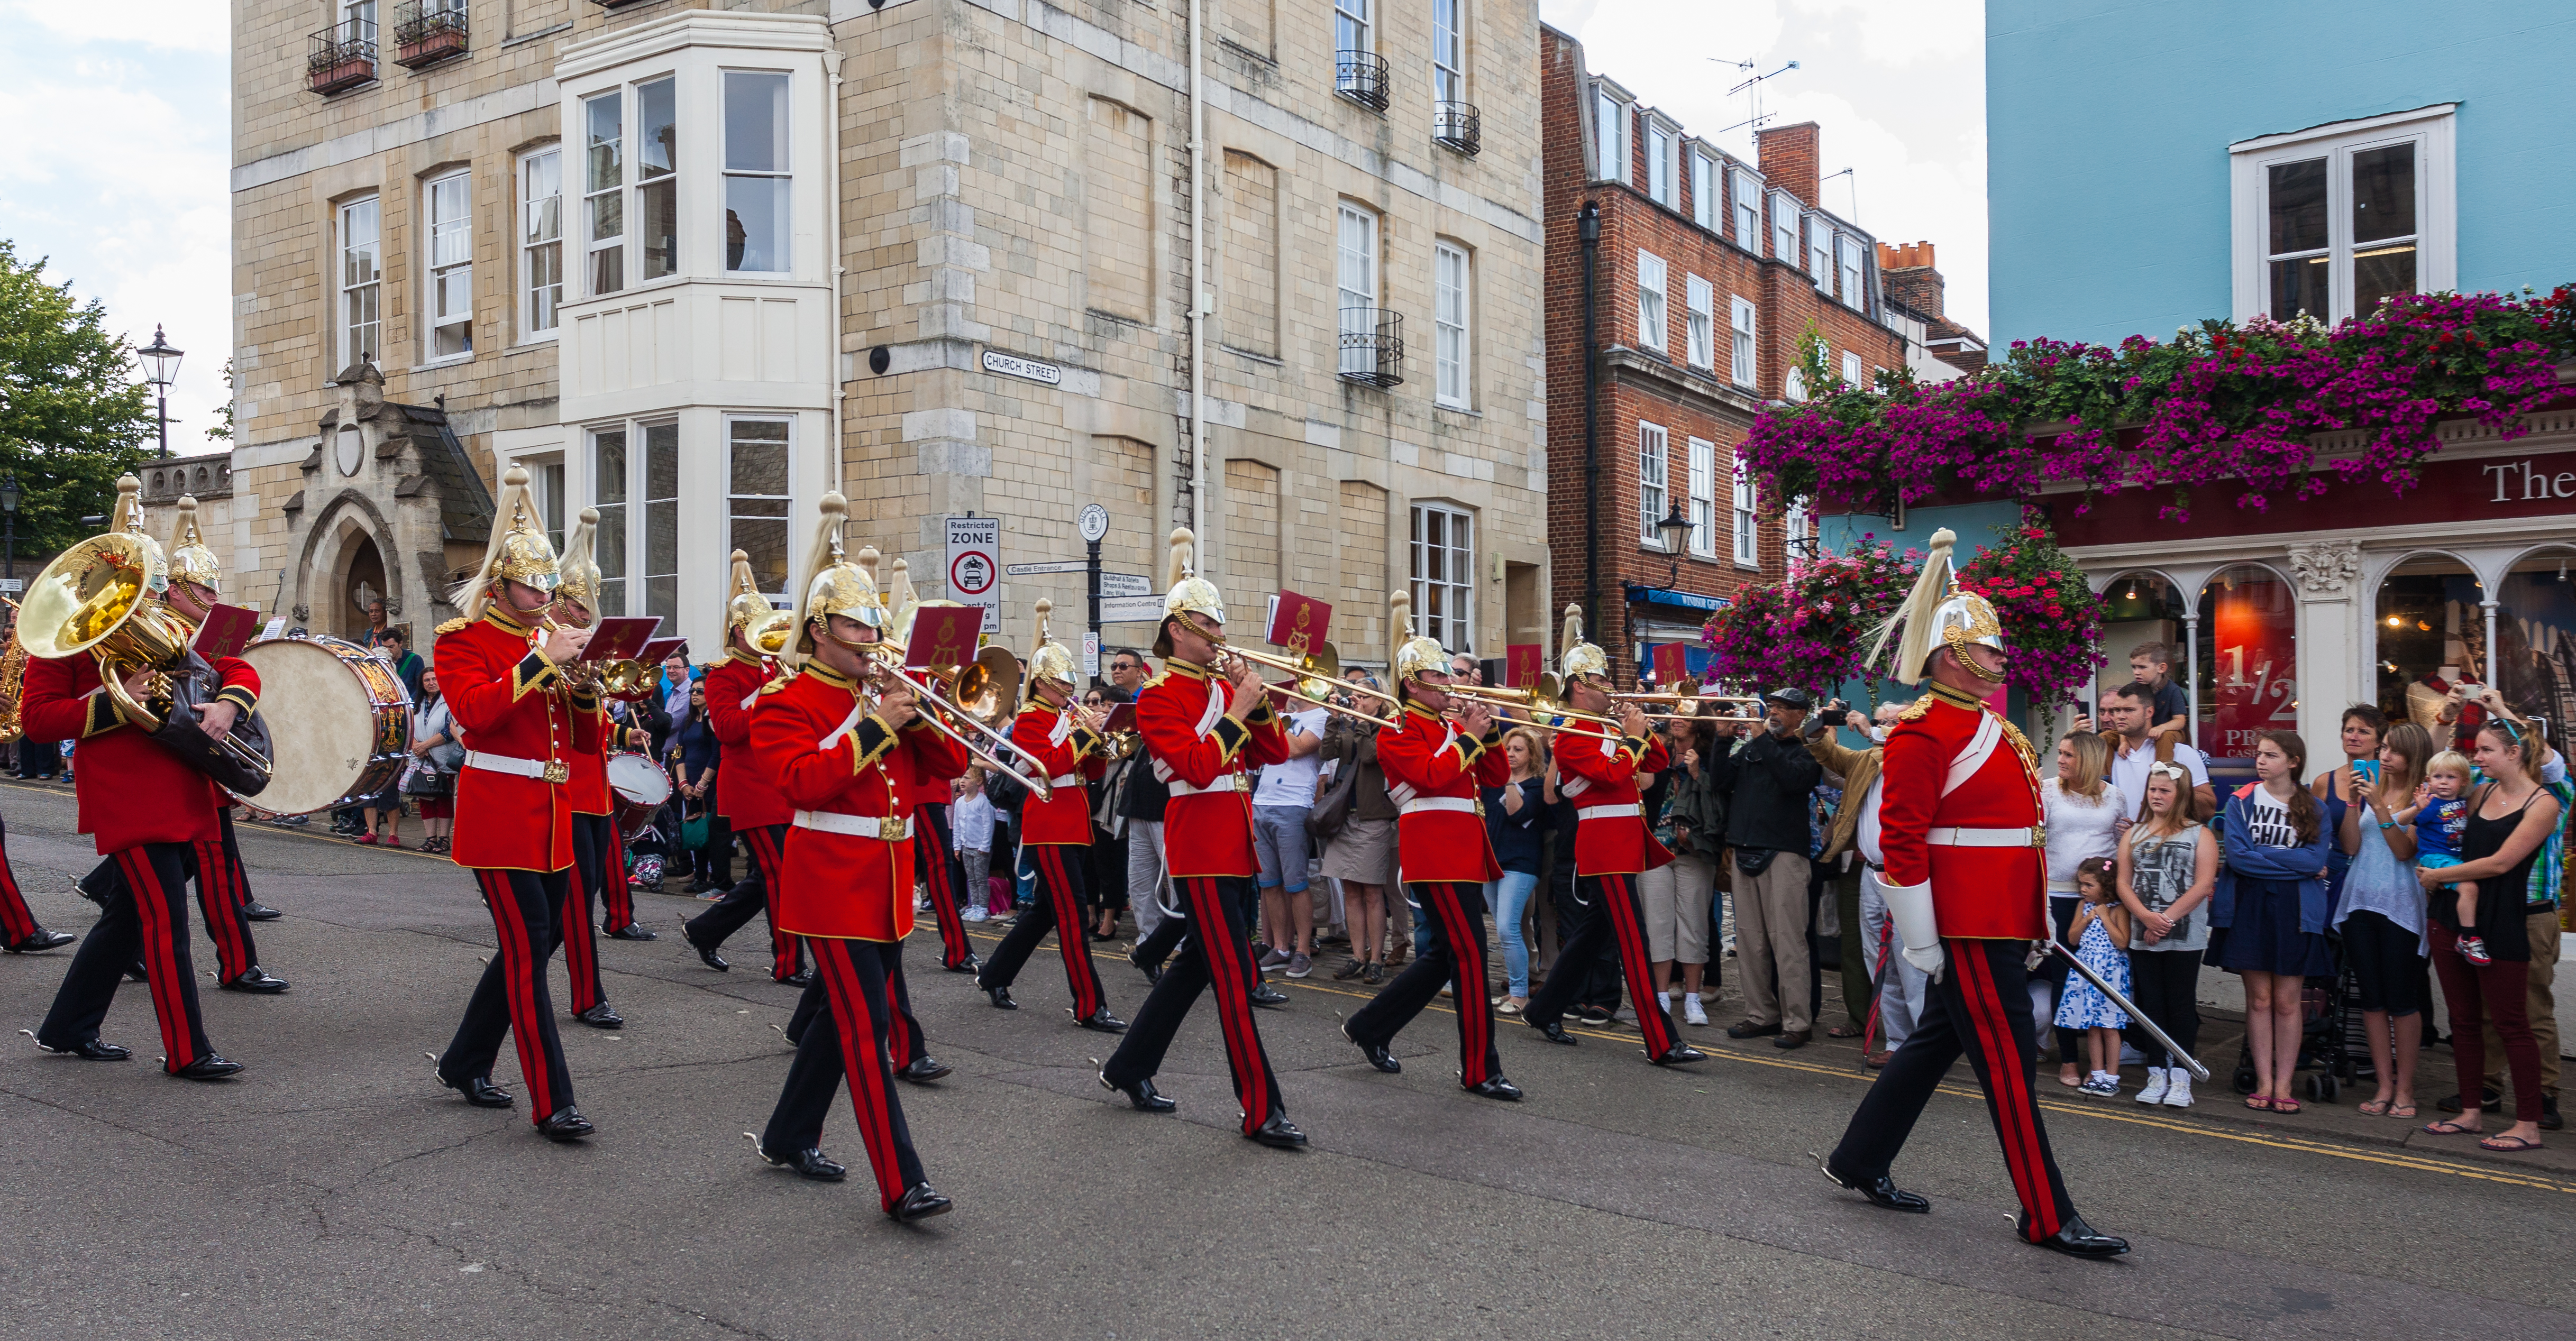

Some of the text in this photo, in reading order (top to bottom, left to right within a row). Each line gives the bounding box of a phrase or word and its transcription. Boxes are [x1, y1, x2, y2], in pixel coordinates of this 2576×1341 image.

[987, 355, 1056, 380] CHURCH STREET
[2482, 460, 2576, 502] The
[1079, 505, 1107, 524] GUILDHALL
[951, 532, 993, 544] ZONE
